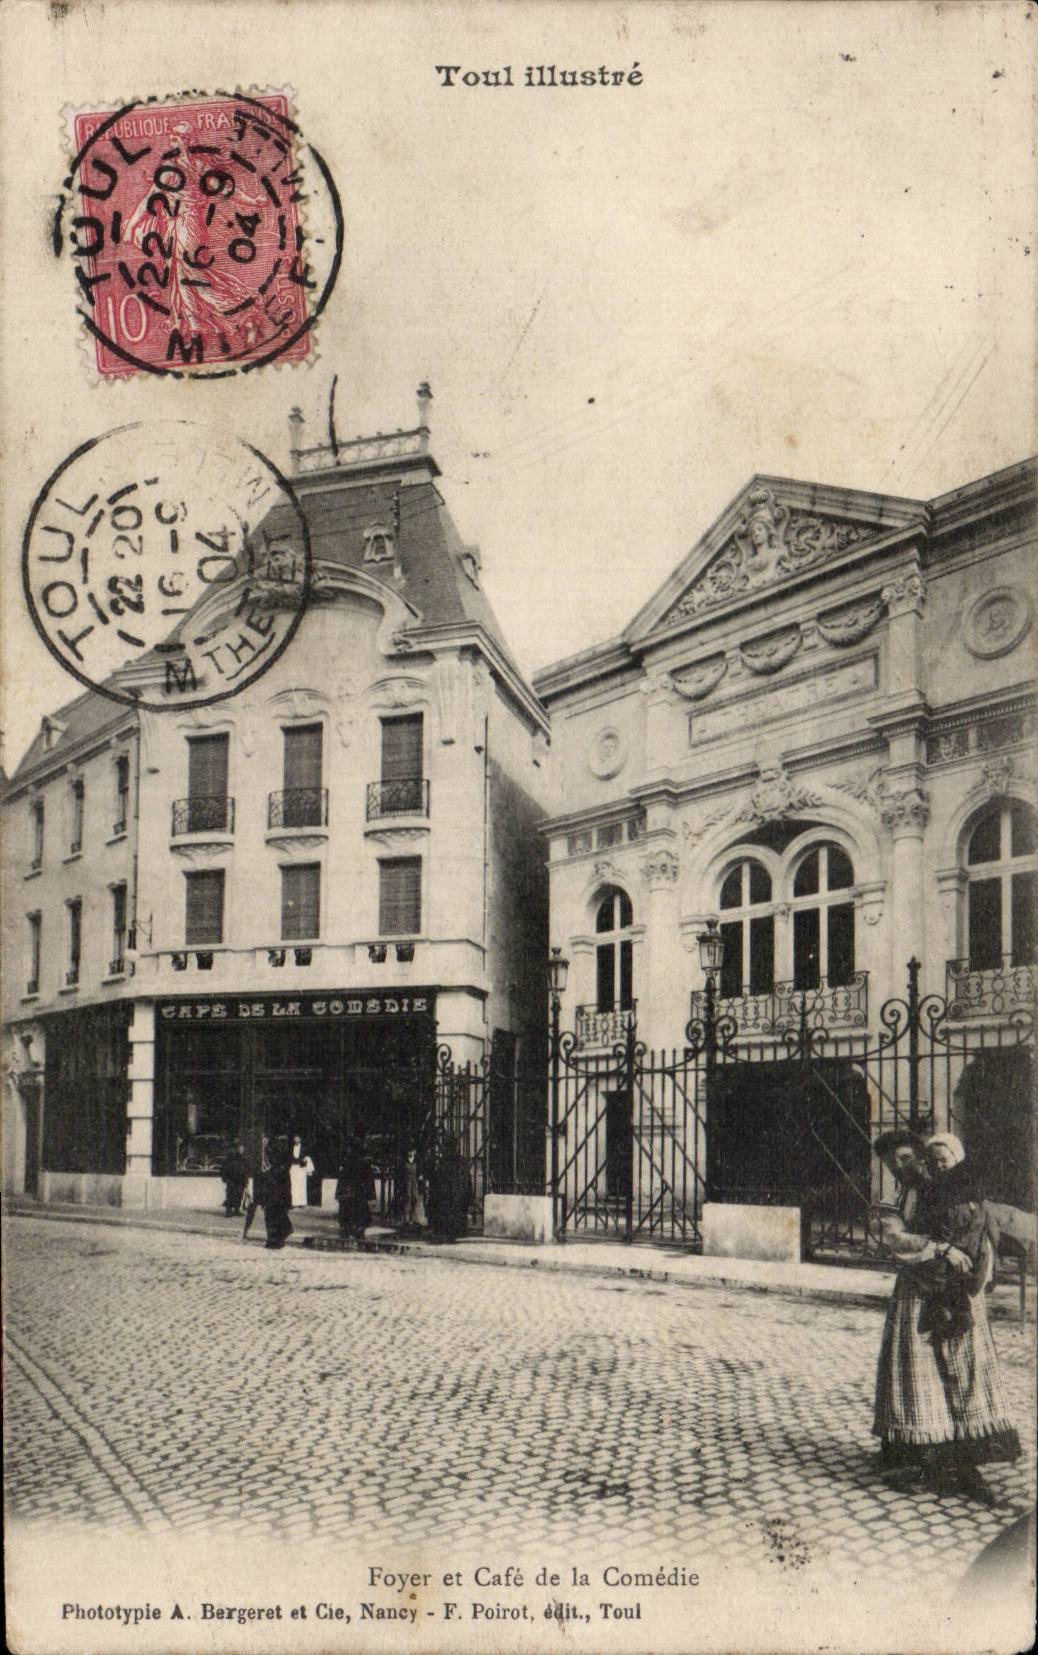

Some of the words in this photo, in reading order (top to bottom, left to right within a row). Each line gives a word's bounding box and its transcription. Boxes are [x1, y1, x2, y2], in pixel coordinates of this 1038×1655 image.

[70, 137, 153, 306] TOUL
[106, 293, 148, 345] 10
[36, 494, 99, 662] TOUL
[238, 1003, 266, 1018] DE
[271, 1001, 301, 1017] LA
